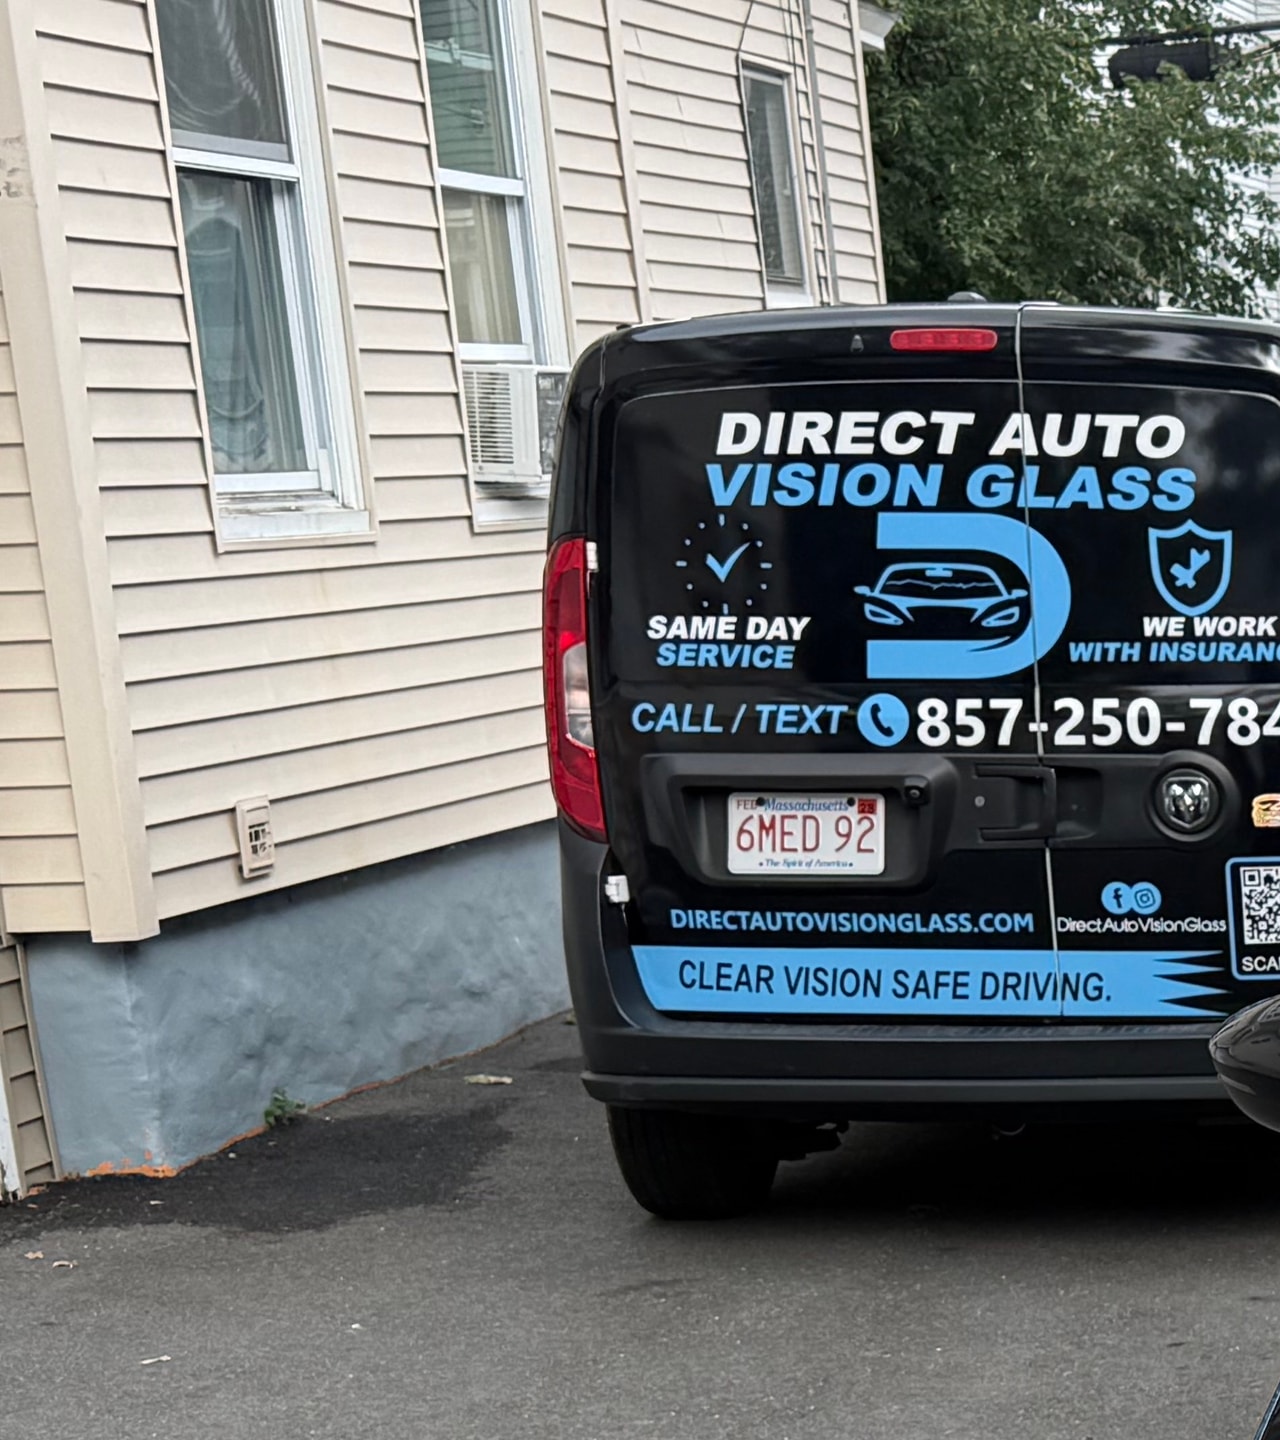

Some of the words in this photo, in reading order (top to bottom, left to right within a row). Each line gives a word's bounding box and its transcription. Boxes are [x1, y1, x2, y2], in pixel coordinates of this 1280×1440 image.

[714, 410, 976, 456] DIRECT
[987, 412, 1187, 459] AUTO
[704, 462, 945, 507] VISION
[965, 464, 1197, 511] GLASS
[646, 615, 738, 640] SAME
[745, 616, 812, 641] DAY
[1142, 616, 1185, 637] WE
[1192, 615, 1279, 638] WORK
[655, 643, 797, 669] SERVICE
[1069, 641, 1142, 663] WITH
[631, 702, 724, 734] CALL
[731, 704, 748, 734] /
[754, 704, 850, 734] TEXT
[764, 798, 849, 812] Massachusetts
[736, 814, 821, 853] 6MED
[834, 815, 875, 853] 92
[765, 858, 780, 867] The
[669, 908, 1035, 933] DIRECTAUTOVISIONGLASS.COM
[1056, 916, 1228, 933] DirectAutoVisionGlass
[678, 959, 775, 995] CLEAR
[784, 965, 882, 999] VISION
[891, 969, 972, 1001] SAFE
[979, 970, 1113, 1003] DRIVING.
